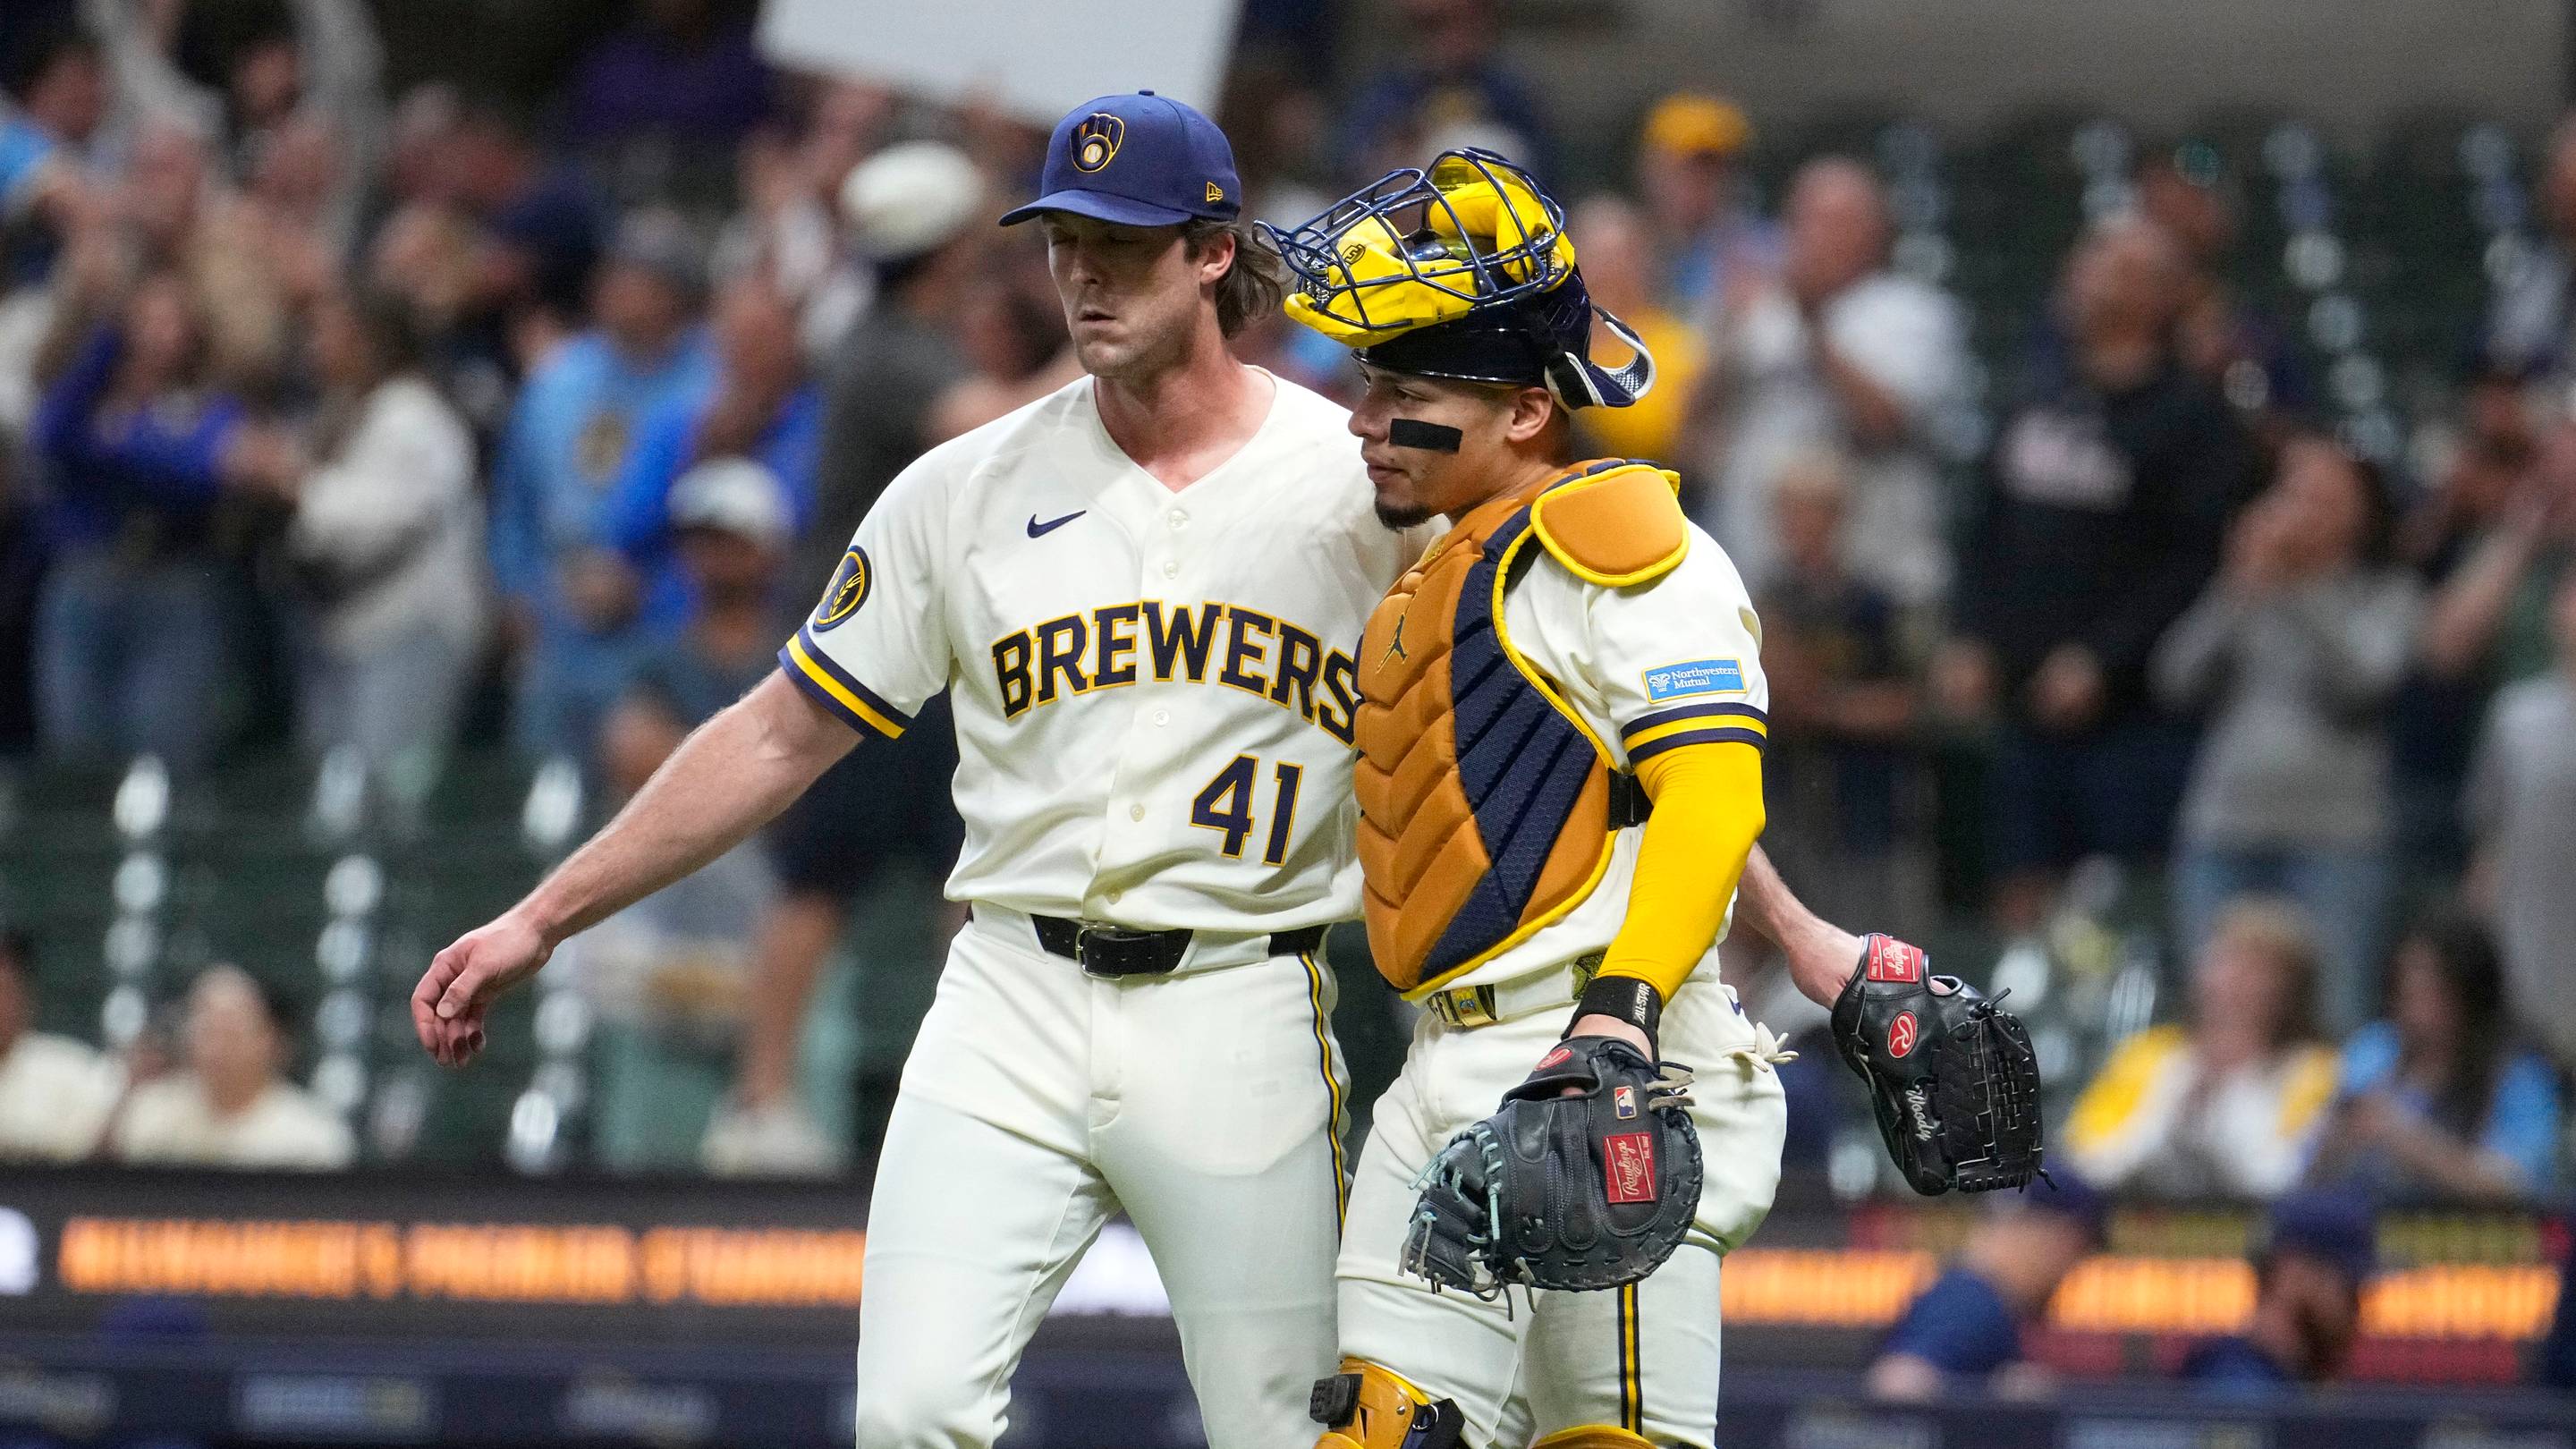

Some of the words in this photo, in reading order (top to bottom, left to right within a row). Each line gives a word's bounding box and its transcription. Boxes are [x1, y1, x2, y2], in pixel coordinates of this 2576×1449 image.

[991, 598, 1360, 750] BREWERS
[1671, 666, 1740, 680] Northwestern
[1674, 675, 1711, 690] Mutual
[1189, 752, 1304, 867] 41
[1905, 1084, 1935, 1141] Woody
[1617, 1139, 1640, 1196] Rawlings
